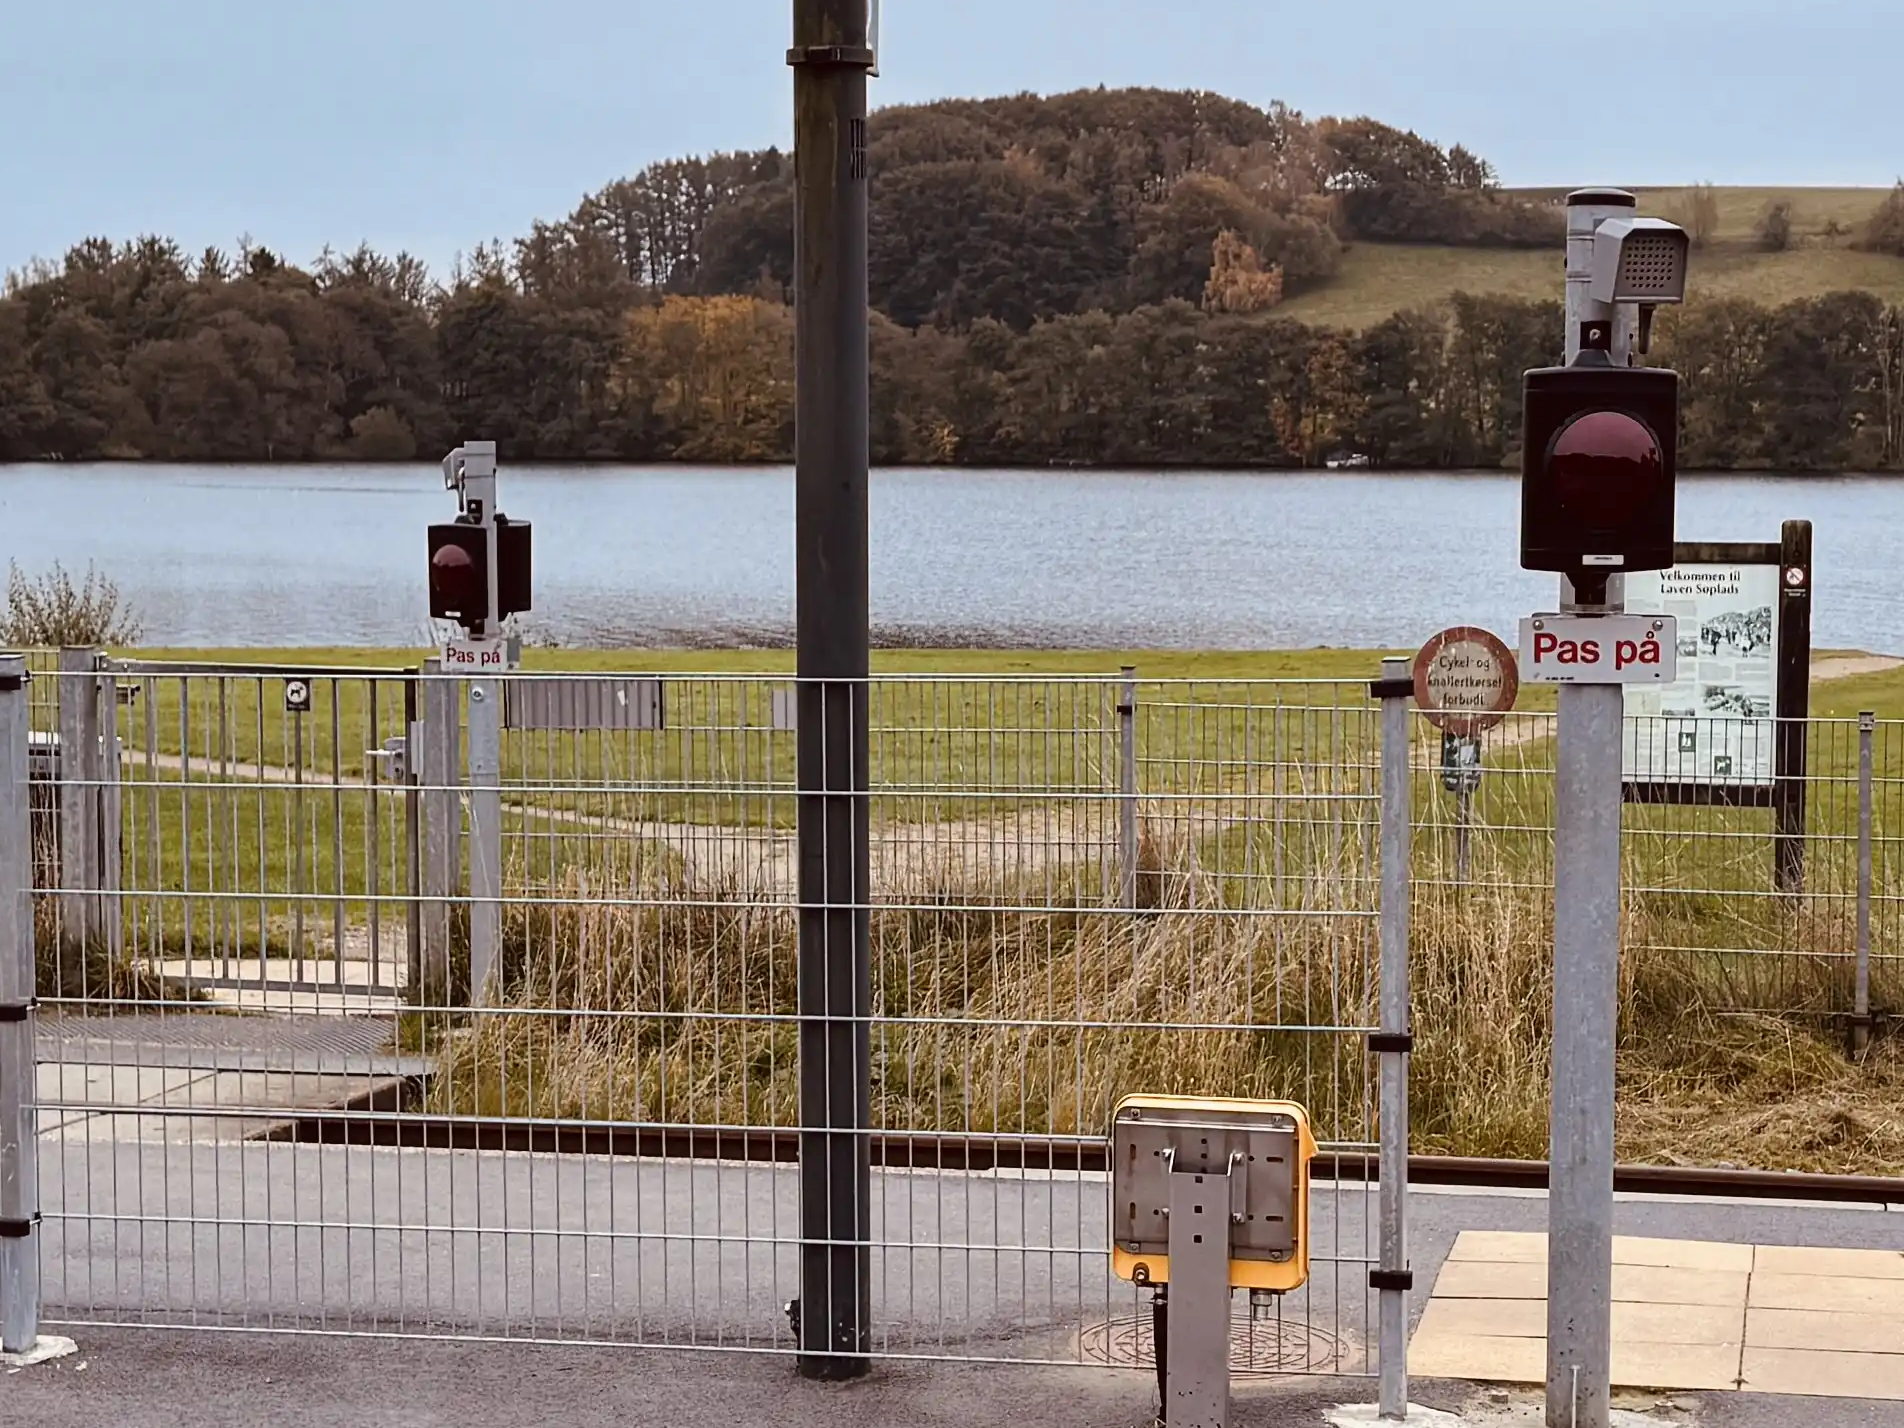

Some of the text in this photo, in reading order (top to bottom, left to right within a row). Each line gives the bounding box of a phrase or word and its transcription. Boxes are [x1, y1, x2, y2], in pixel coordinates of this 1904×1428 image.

[1659, 569, 1741, 582] Velkommen til
[1660, 583, 1693, 594] Laven
[446, 647, 475, 663] Pas
[1534, 630, 1661, 671] Pas på
[1476, 658, 1490, 671] og
